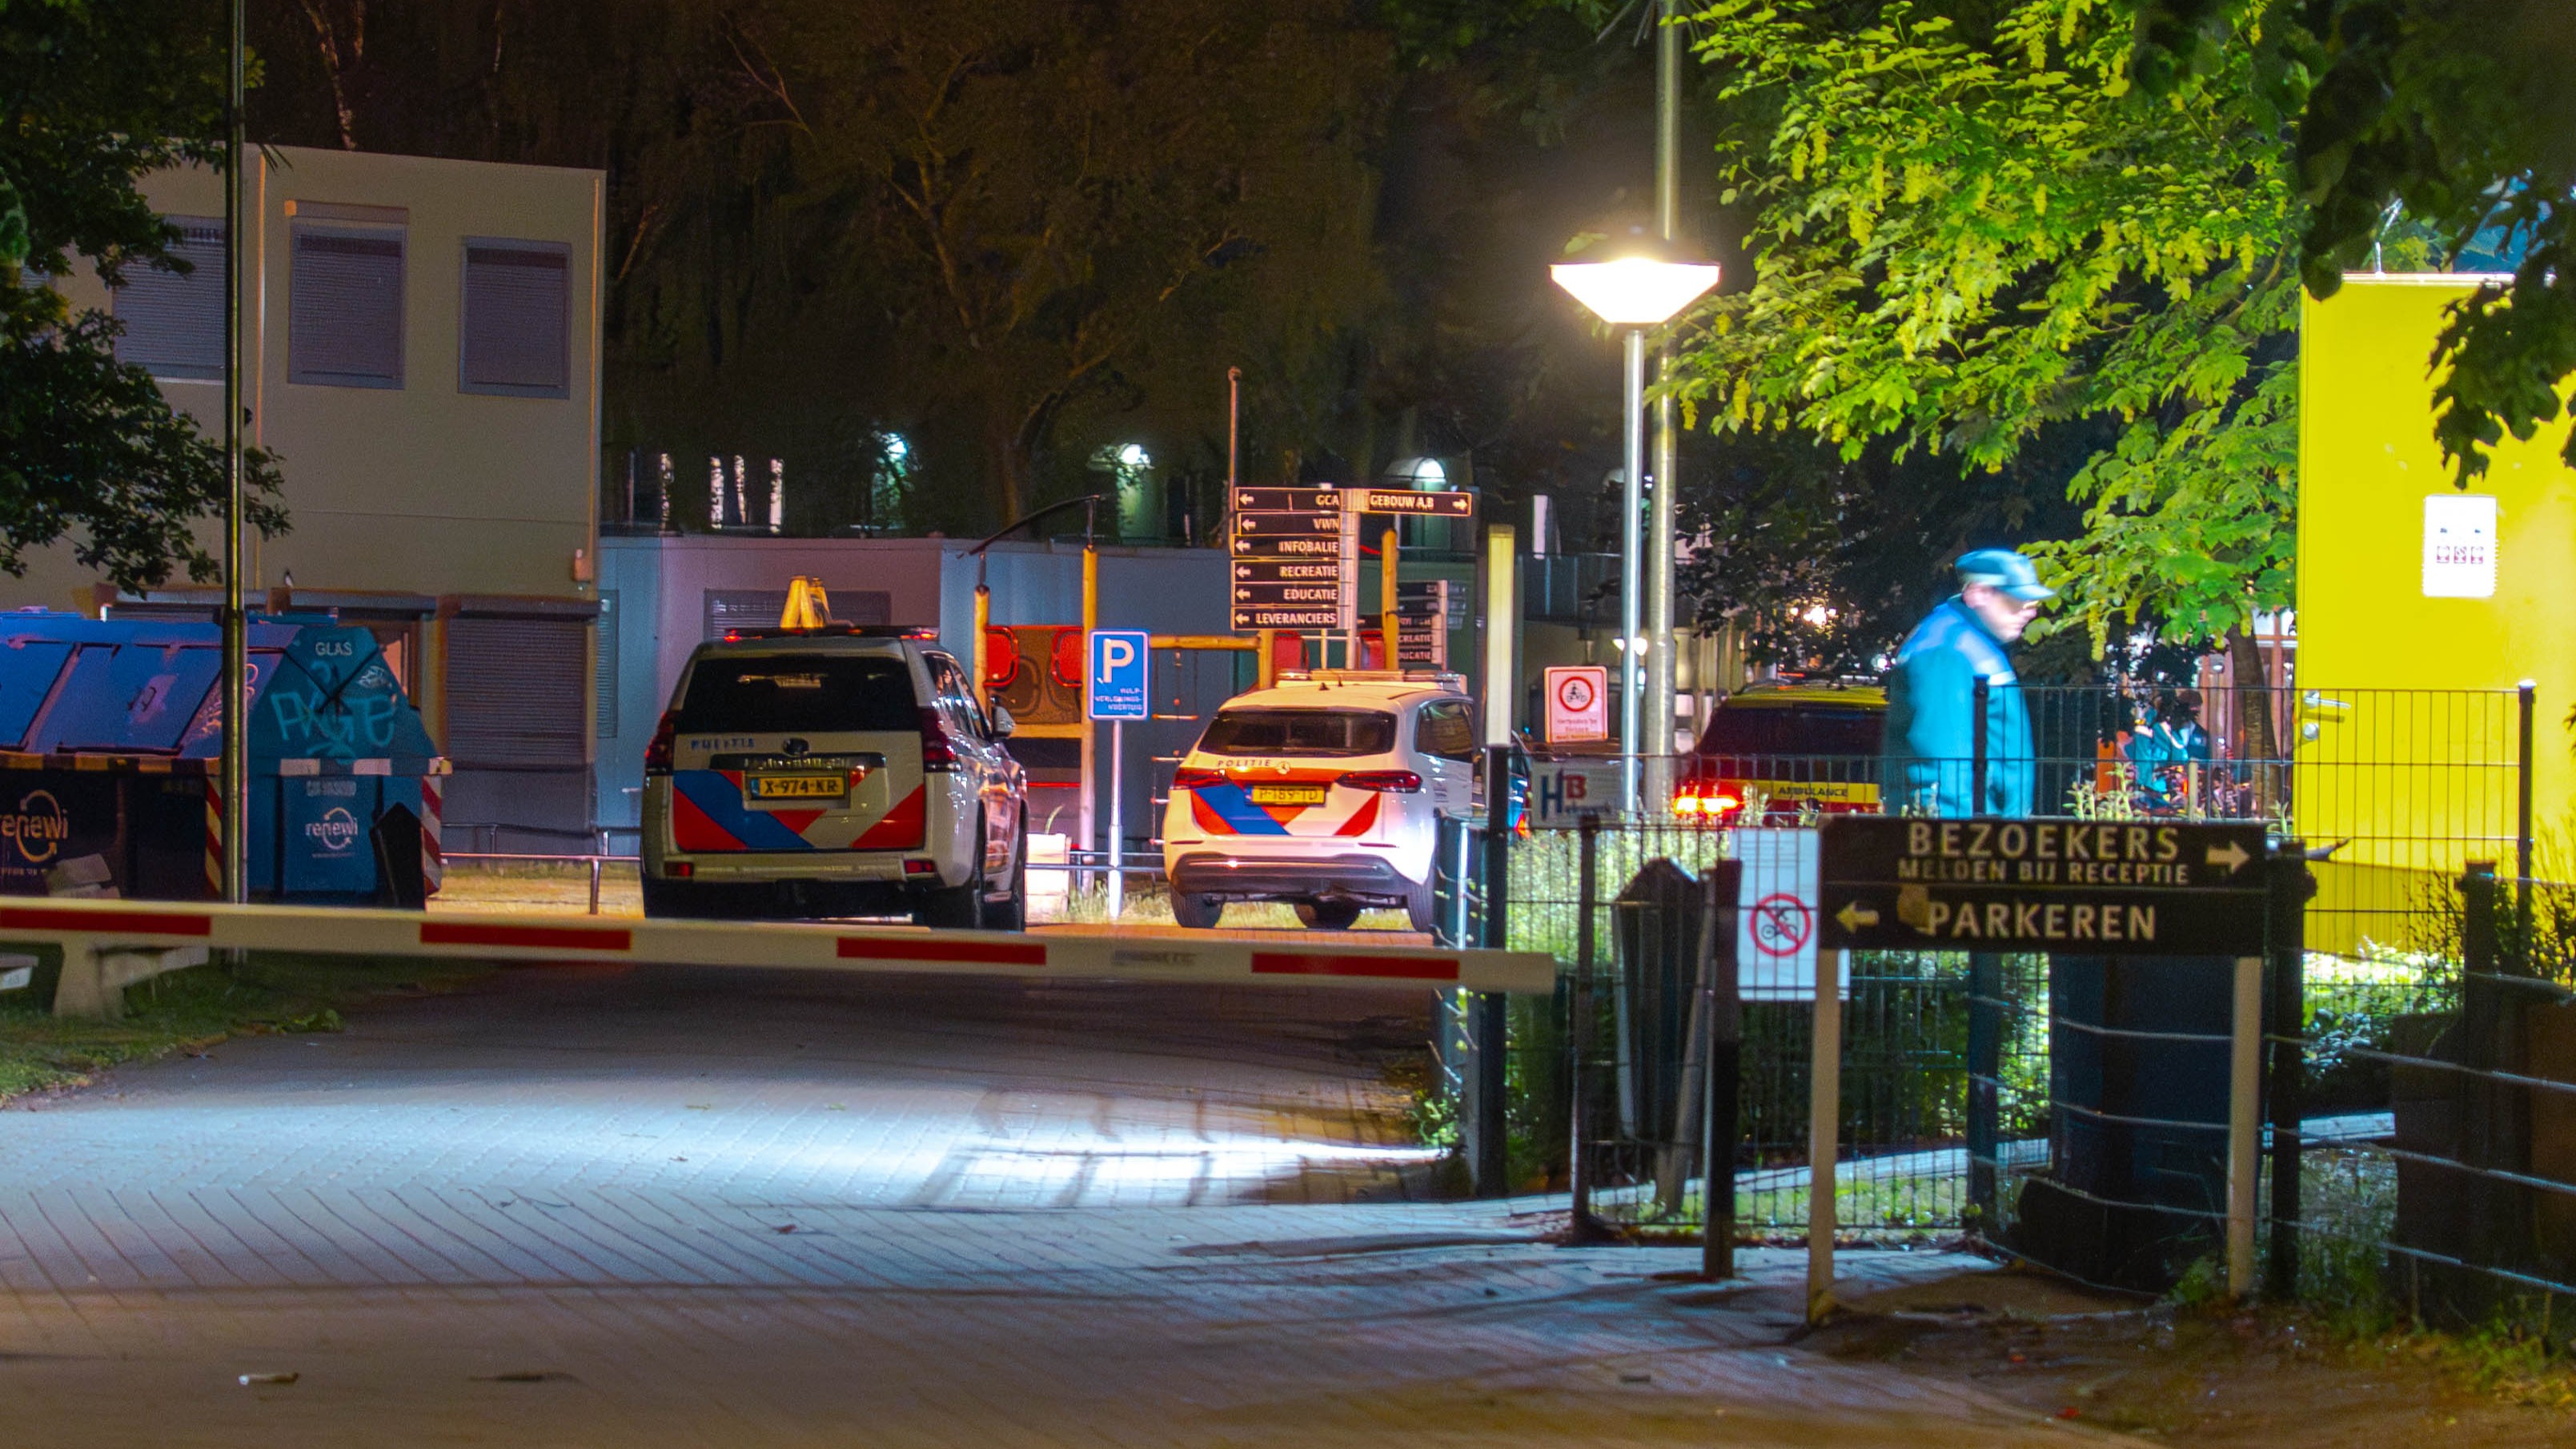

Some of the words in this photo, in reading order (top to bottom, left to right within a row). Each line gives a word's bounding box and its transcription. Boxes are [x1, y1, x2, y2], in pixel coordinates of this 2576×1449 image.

[1370, 494, 1415, 508] GEBOUW
[1278, 540, 1338, 552] INFOBALIE
[1279, 566, 1338, 577] RECREATIE
[1283, 588, 1338, 600] EDUCATIE
[1255, 612, 1337, 624] LEVERANCIERS
[315, 641, 353, 656] GLAS
[1103, 639, 1135, 684] P
[1217, 759, 1270, 768] POLITIE
[1779, 786, 1848, 797] AMBULANCE
[0, 808, 69, 839] enewi
[305, 817, 358, 837] renewi
[1909, 821, 2179, 861] BEZOEKERS
[1897, 857, 2007, 880] MELDEN
[2018, 860, 2057, 881] BIJ
[2068, 862, 2189, 884] RECEPTIE
[1928, 901, 2157, 941] PARKEREN
